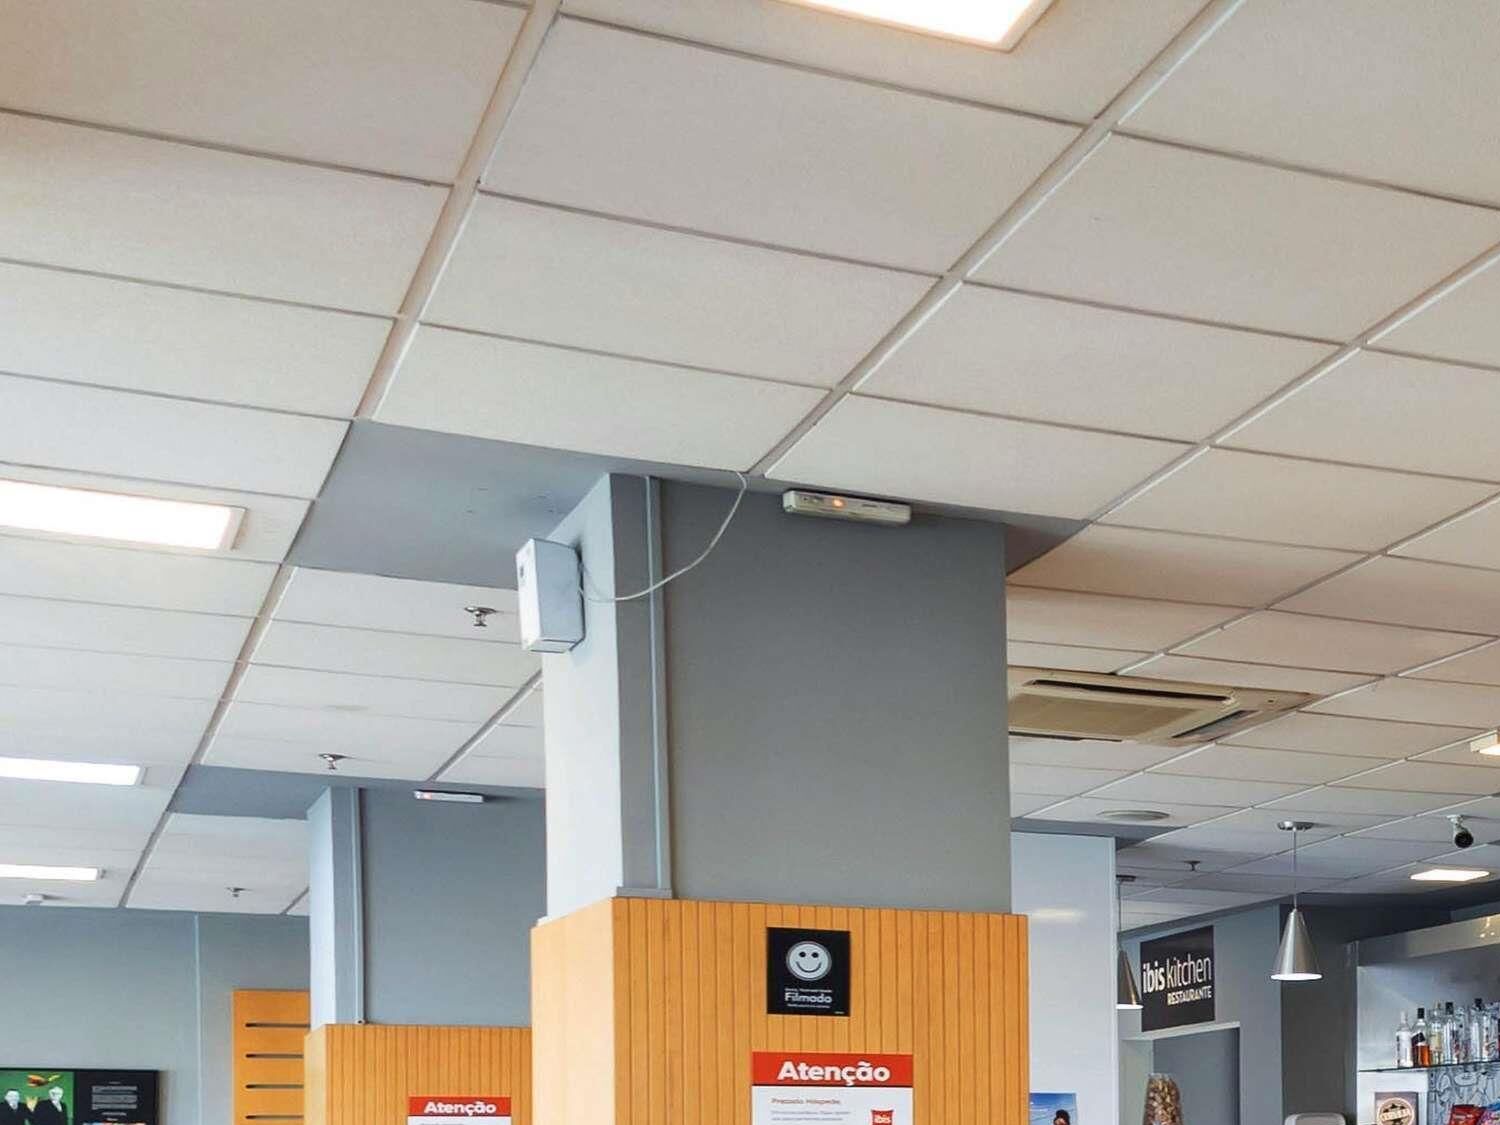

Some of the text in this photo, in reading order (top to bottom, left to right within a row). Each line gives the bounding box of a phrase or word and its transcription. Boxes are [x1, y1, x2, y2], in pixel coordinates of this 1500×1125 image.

[1142, 953, 1212, 993] ibis kitchen
[1167, 985, 1212, 1006] RESTAURANTE
[777, 1061, 890, 1086] Atenção
[424, 1101, 497, 1116] Atenção
